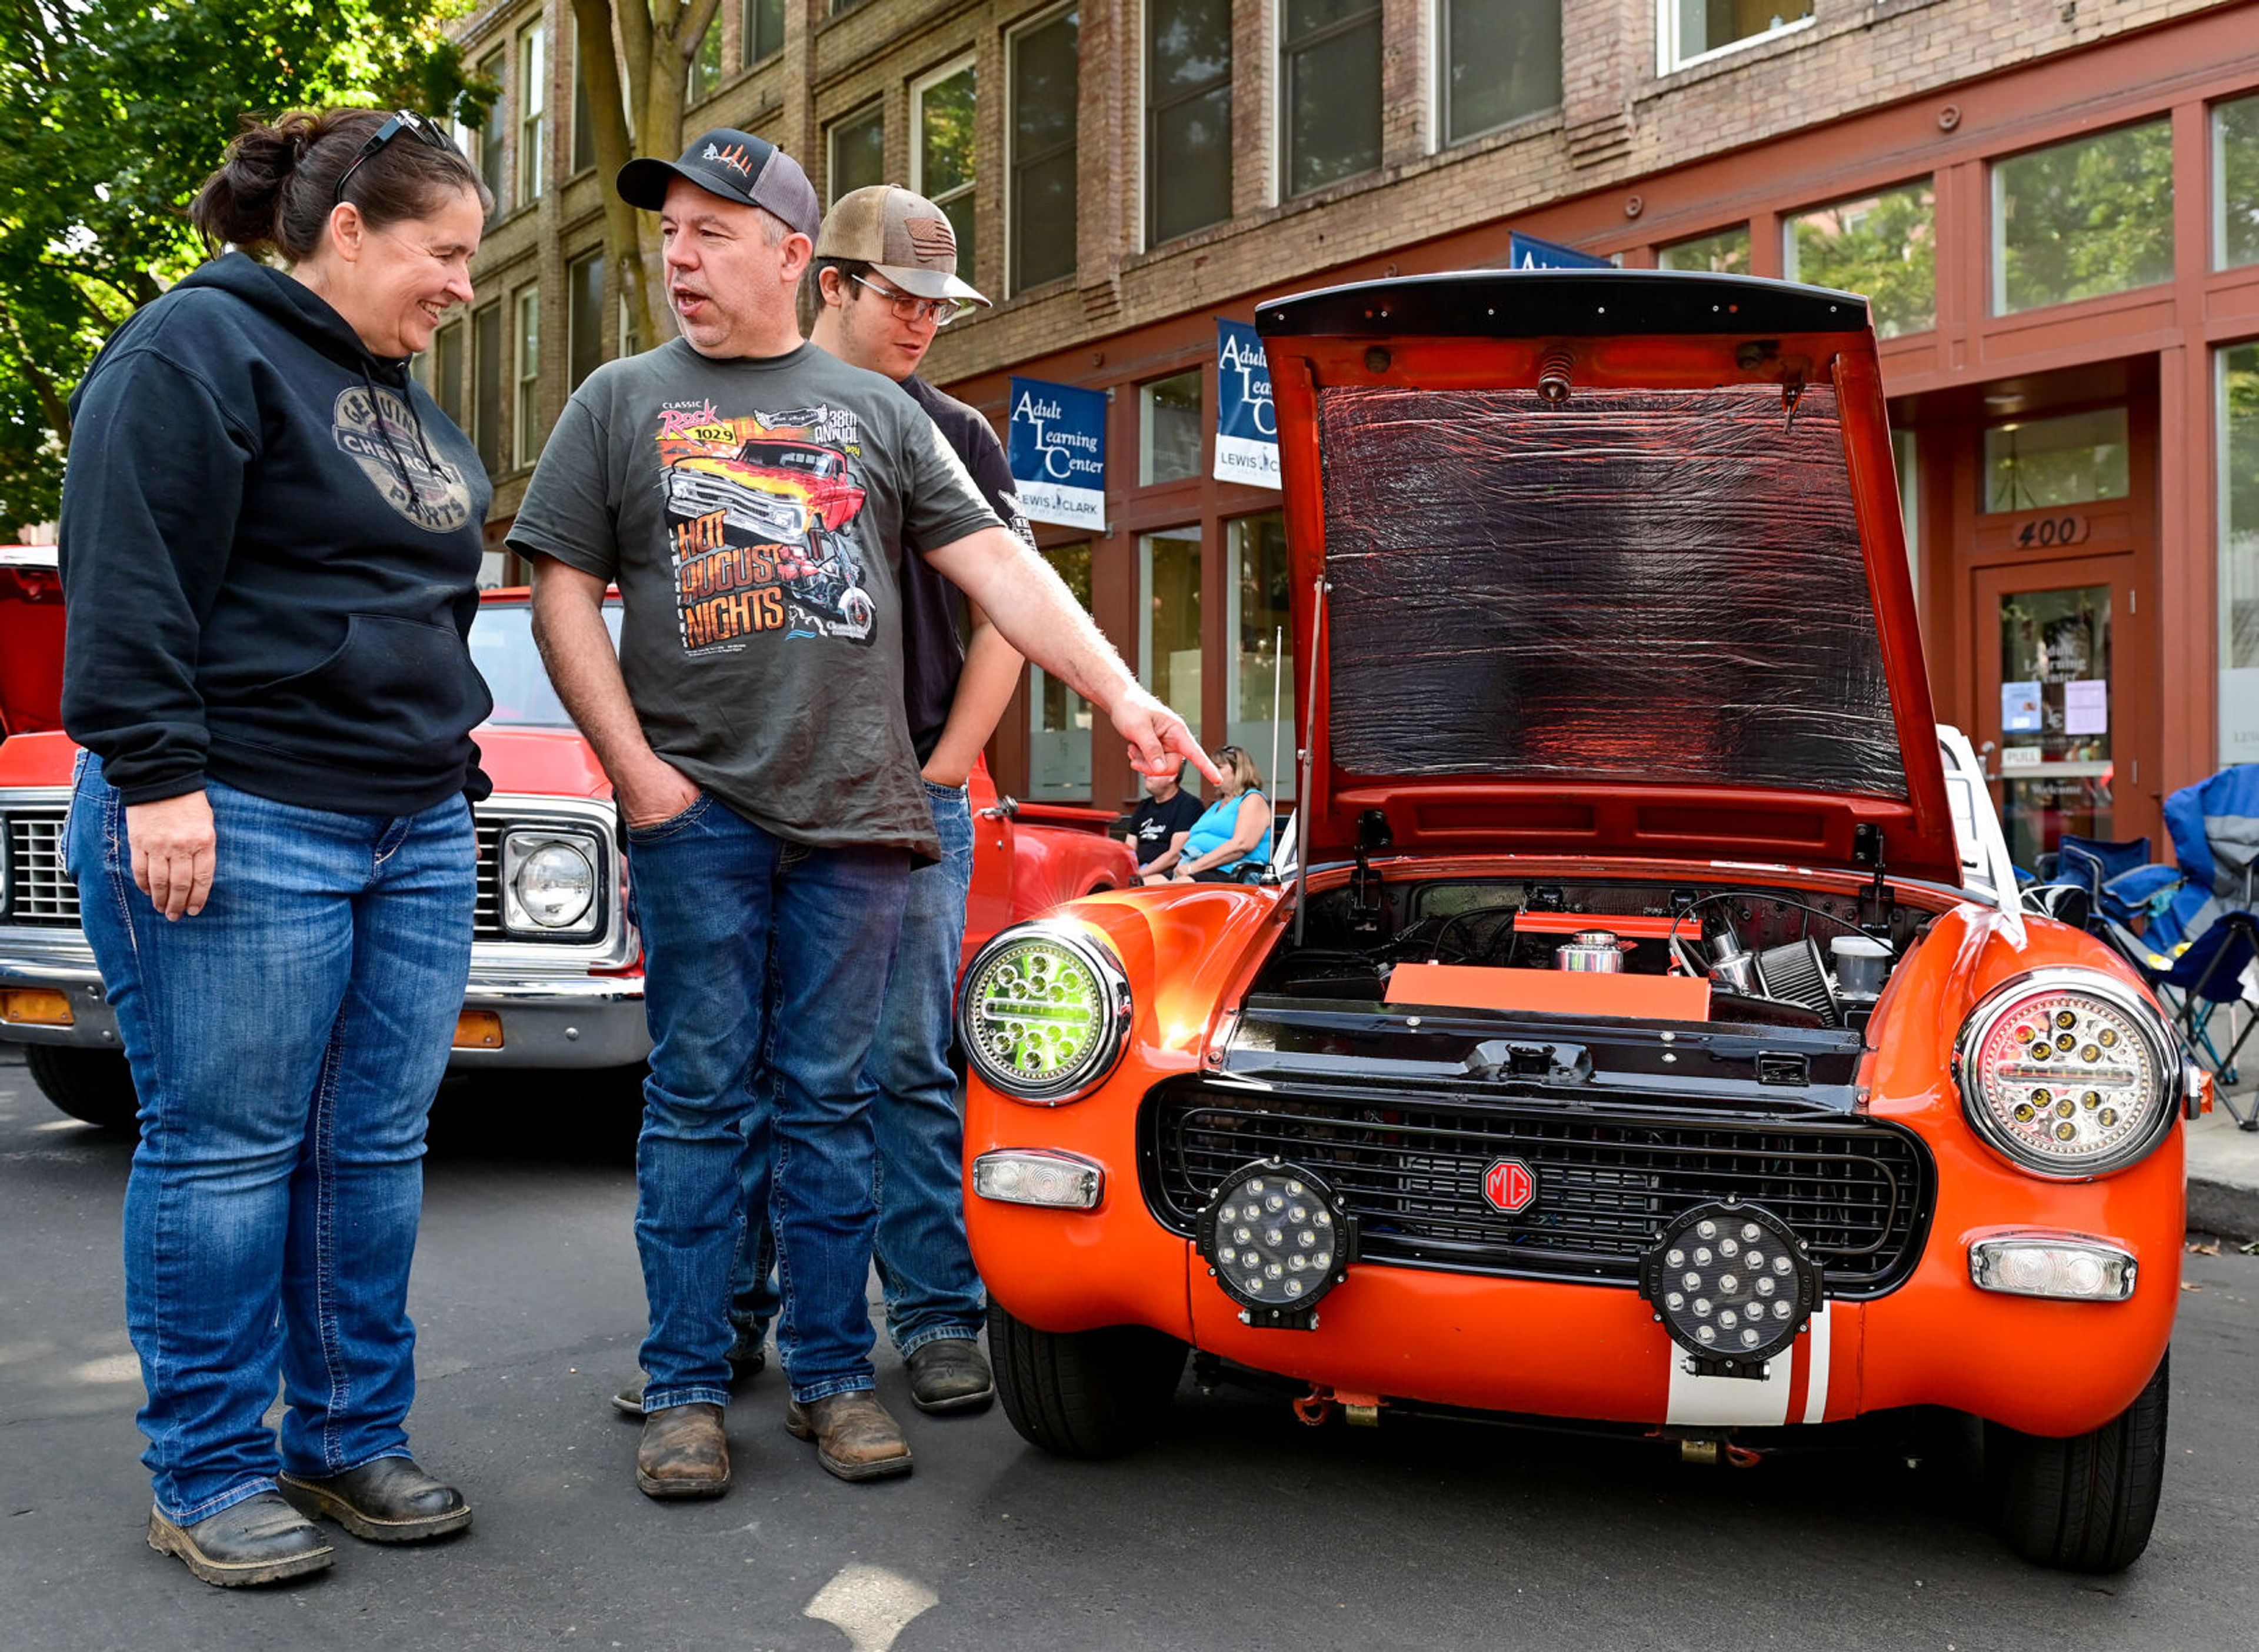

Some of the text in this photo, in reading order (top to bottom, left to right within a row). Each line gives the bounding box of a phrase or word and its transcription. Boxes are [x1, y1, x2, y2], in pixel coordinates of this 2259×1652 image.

[343, 395, 417, 436] GENUIN
[662, 401, 702, 409] CLASSIC
[829, 410, 858, 428] 38th
[1012, 390, 1062, 424] Adult
[695, 429, 734, 441] 102.9
[814, 425, 859, 443] ANNUAL
[1035, 420, 1098, 453] Learning
[1045, 446, 1104, 479] Center
[1221, 452, 1257, 468] LEWIS
[389, 485, 465, 526] PARTS
[1022, 494, 1050, 508] EWIS
[1062, 500, 1098, 515] CLARK
[678, 508, 727, 561] HOT
[2018, 518, 2075, 548] 400
[681, 543, 784, 605] AUGUST
[685, 586, 785, 649] NIGHTS
[1490, 1167, 1528, 1204] MG
